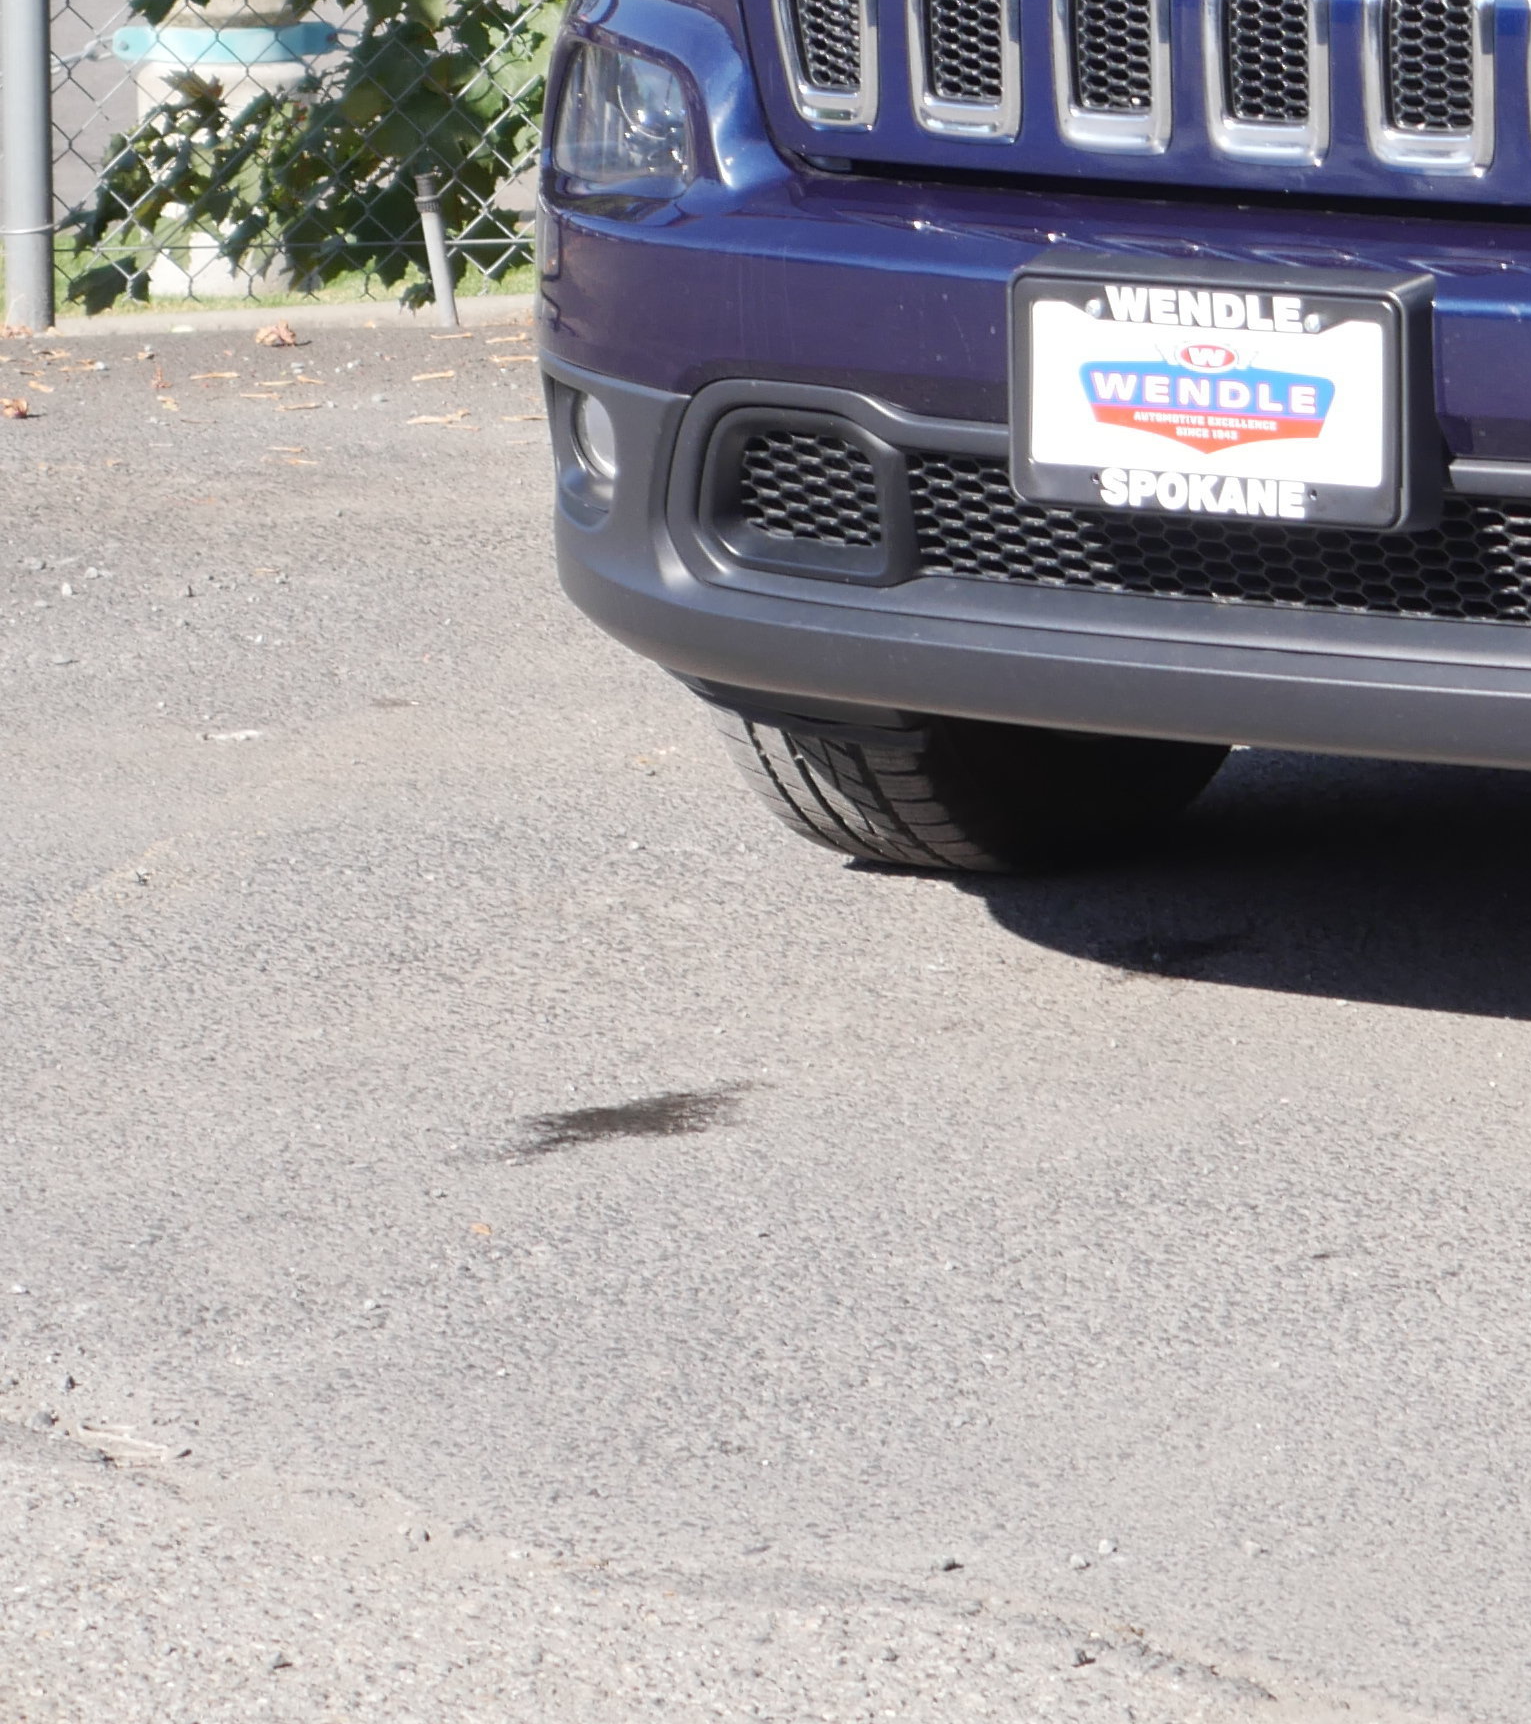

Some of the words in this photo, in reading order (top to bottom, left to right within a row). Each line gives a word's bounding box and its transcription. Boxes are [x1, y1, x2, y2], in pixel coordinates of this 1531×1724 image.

[1104, 285, 1304, 334] WENDLE
[1091, 371, 1318, 415] WENDLE
[1133, 411, 1205, 426] AUTOMOTIVE
[1100, 467, 1306, 519] SPOKANE
